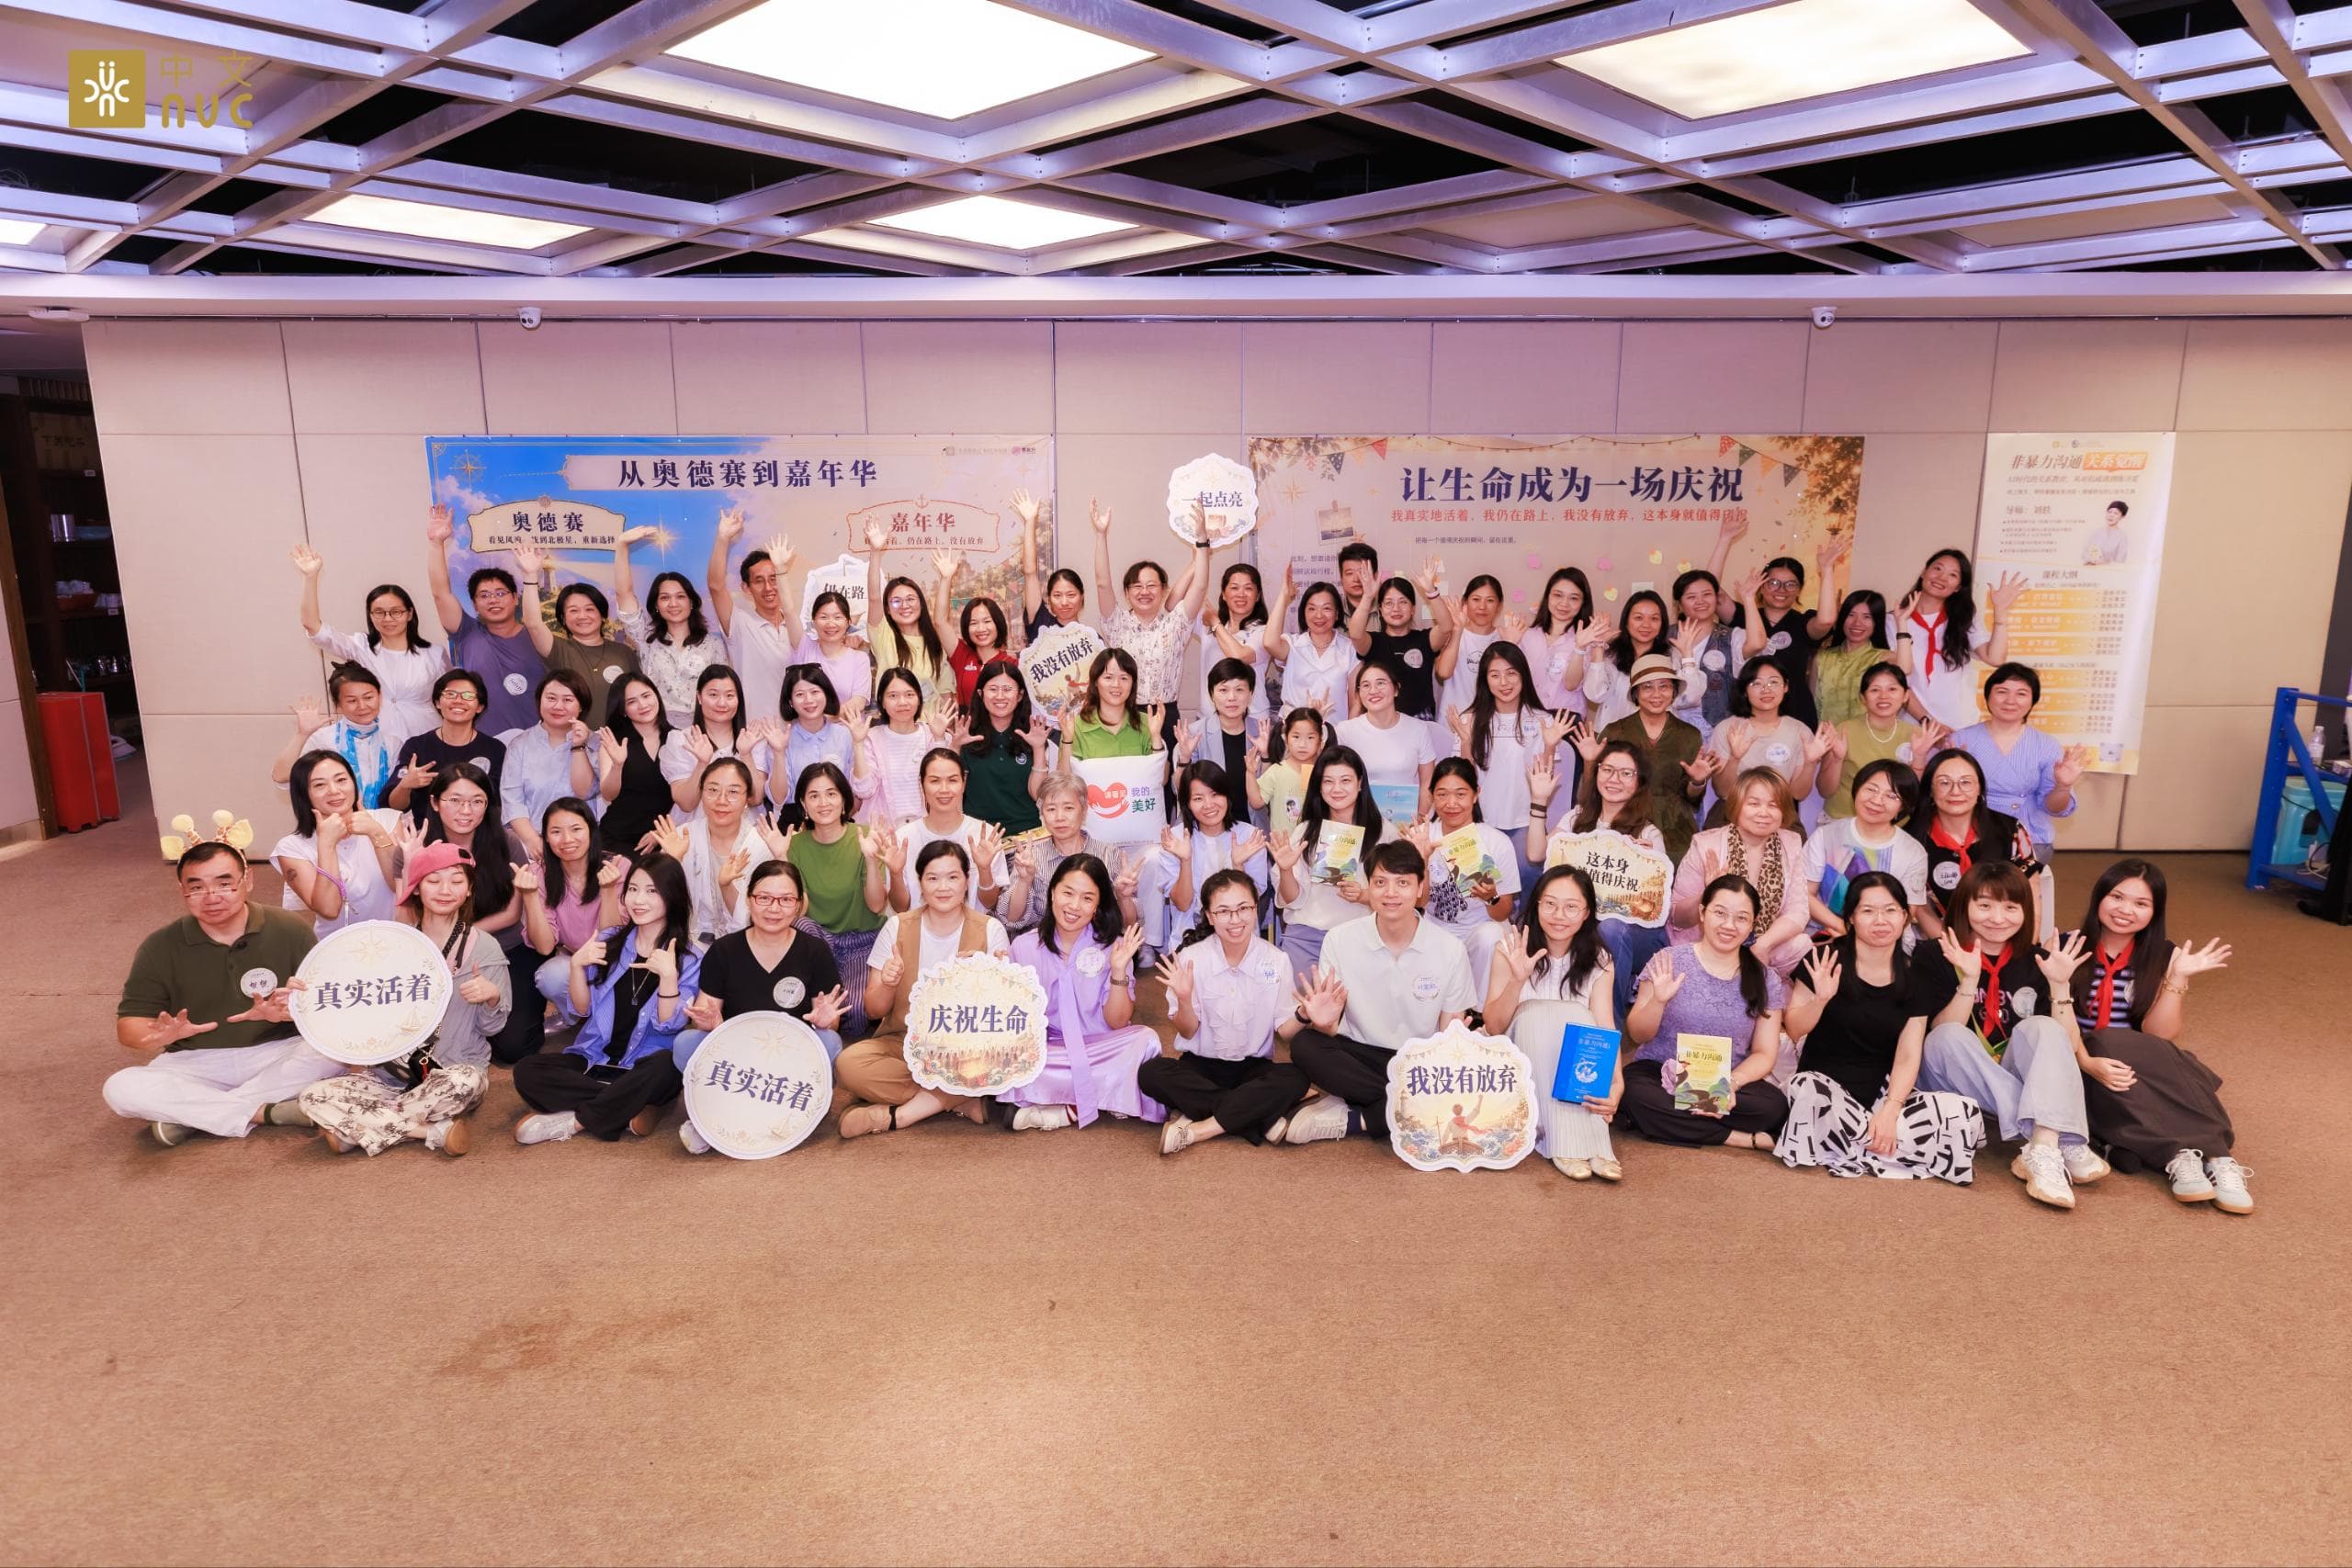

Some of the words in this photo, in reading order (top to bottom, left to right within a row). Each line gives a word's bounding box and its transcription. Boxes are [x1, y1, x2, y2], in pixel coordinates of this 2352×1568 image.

[618, 459, 877, 488] 从奥德赛到嘉年华
[2012, 455, 2082, 469] 非暴力沟通
[1399, 467, 1744, 502] 让生命成为一场庆祝
[1182, 491, 1243, 508] 一起点亮
[513, 512, 584, 533] 奥德赛
[891, 513, 956, 532] 嘉年华
[823, 583, 867, 600] 仍在路
[1030, 637, 1092, 682] 我没有放弃
[1132, 786, 1150, 797] 我的
[1132, 798, 1156, 813] 美好
[1586, 851, 1629, 874] 这本身
[314, 973, 432, 1011] 真实活着
[928, 1004, 1029, 1035] 庆祝生命
[704, 1060, 814, 1111] 真实活着
[1407, 1065, 1517, 1096] 我没有放弃
